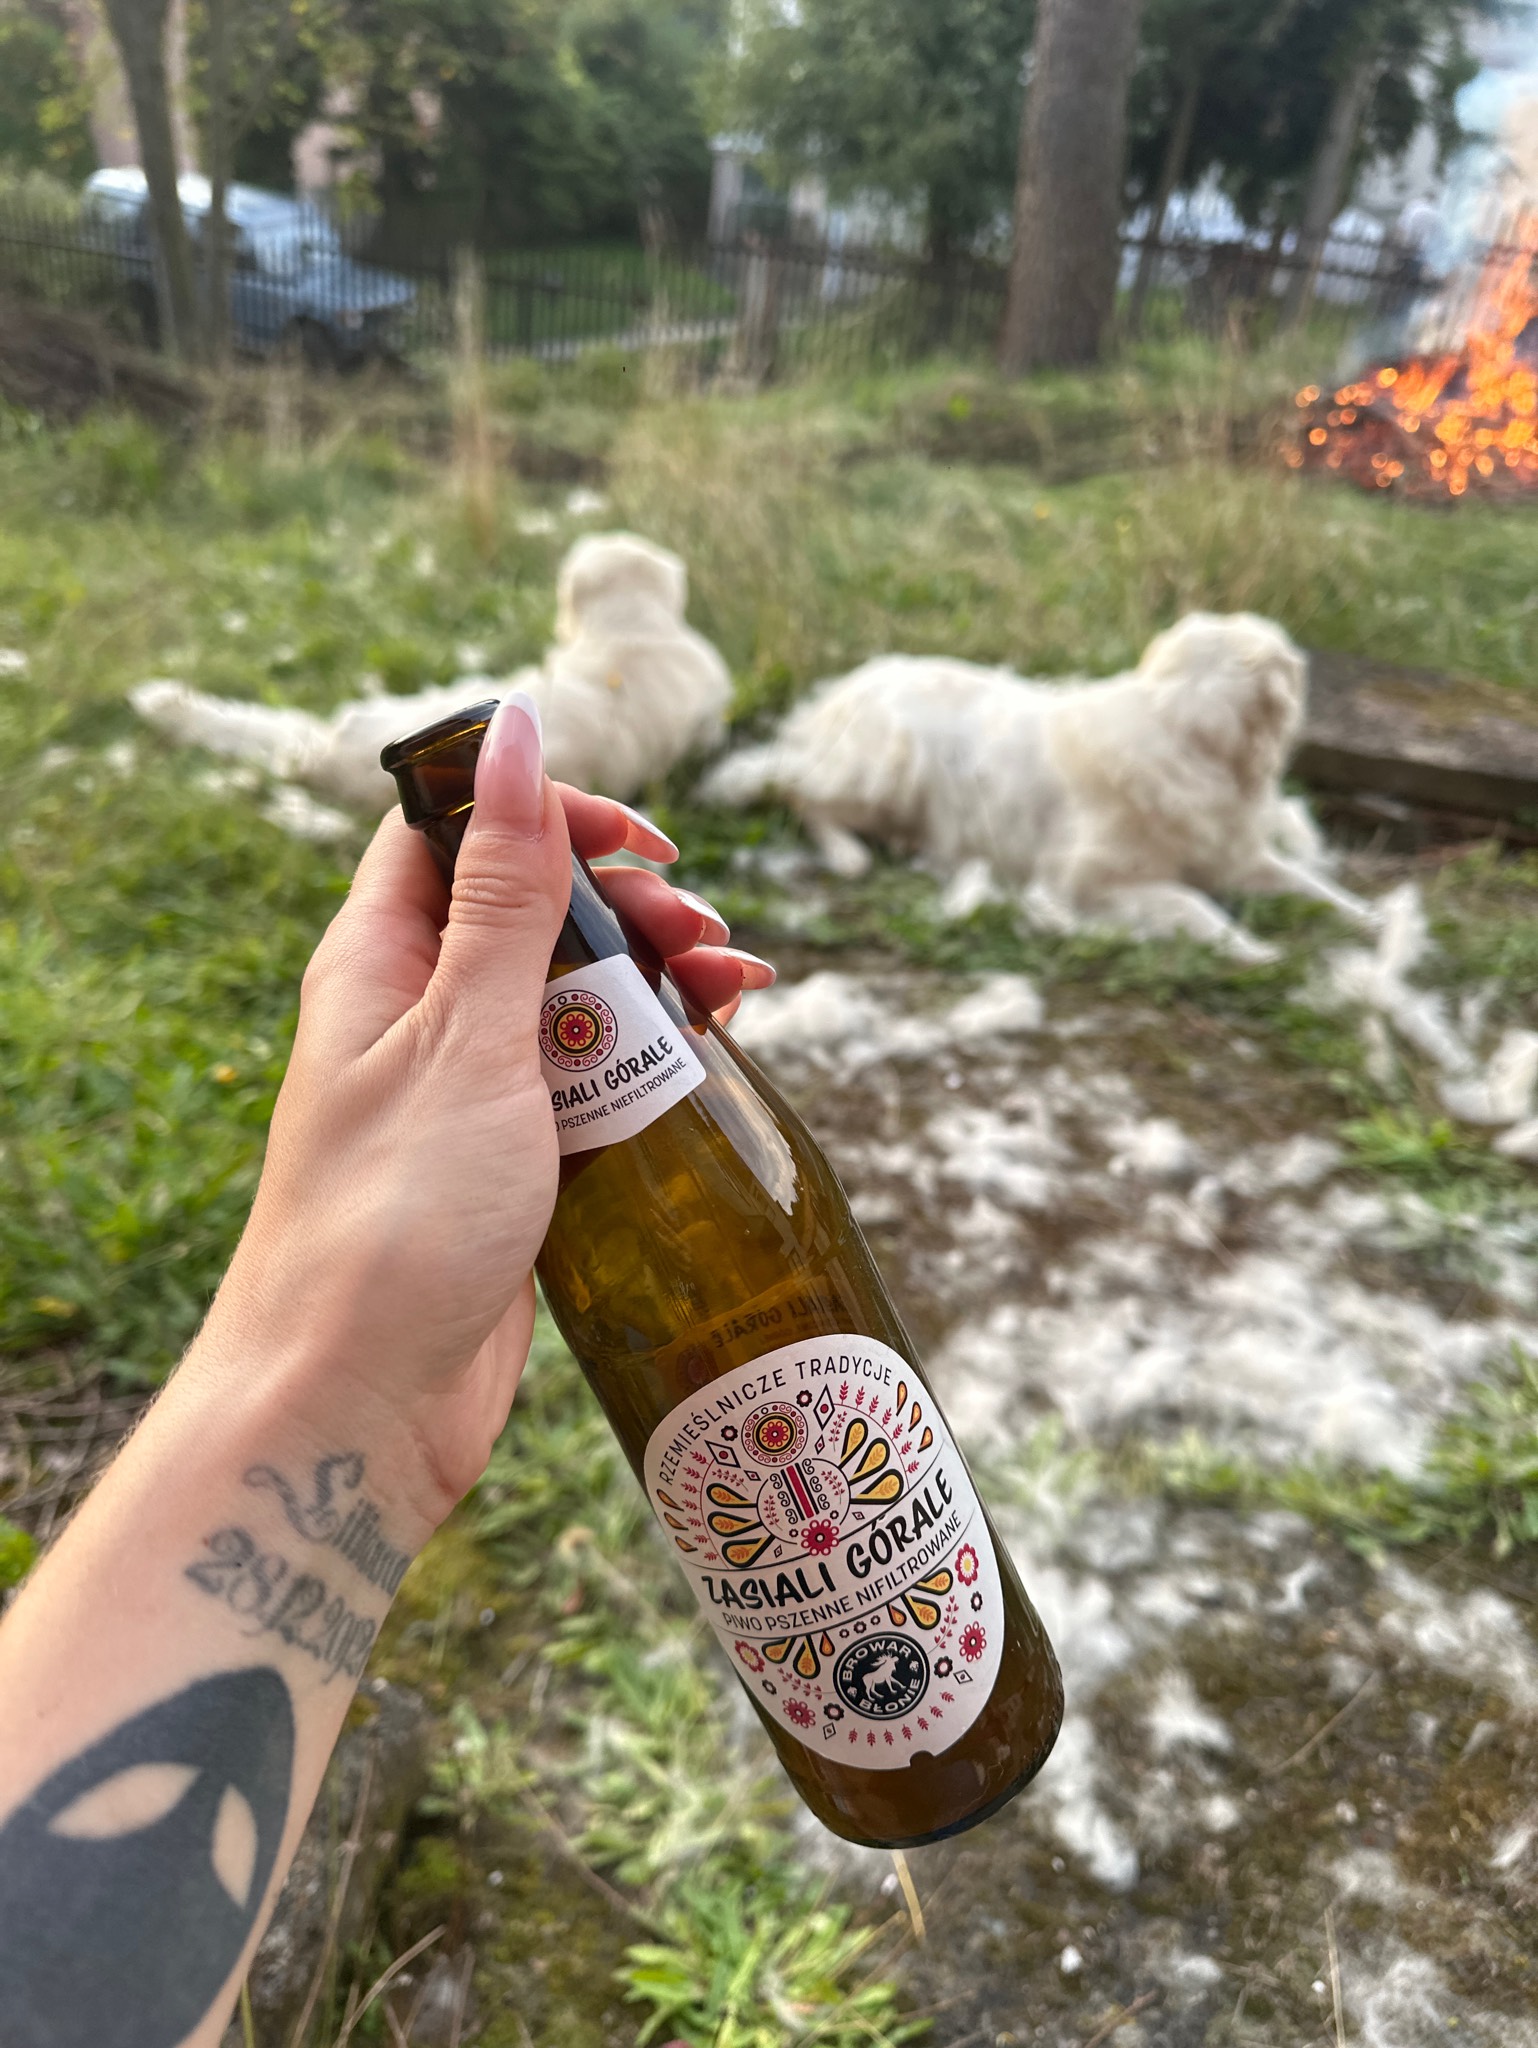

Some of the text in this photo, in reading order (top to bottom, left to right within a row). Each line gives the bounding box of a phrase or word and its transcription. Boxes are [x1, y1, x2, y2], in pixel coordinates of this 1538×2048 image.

[552, 1036, 674, 1111] SIALI GÓRALE
[561, 1057, 687, 1131] PSZENNE NIEFILTROWANE
[659, 1355, 893, 1486] RZEMIEŚLNICZE TRADYCJE
[702, 1468, 953, 1610] ZASIALI GÓRALE
[722, 1509, 962, 1632] PIWO PSZENNE NIFILTROWANE
[842, 1639, 912, 1683] BROWAR
[858, 1677, 921, 1712] BŁONIE
